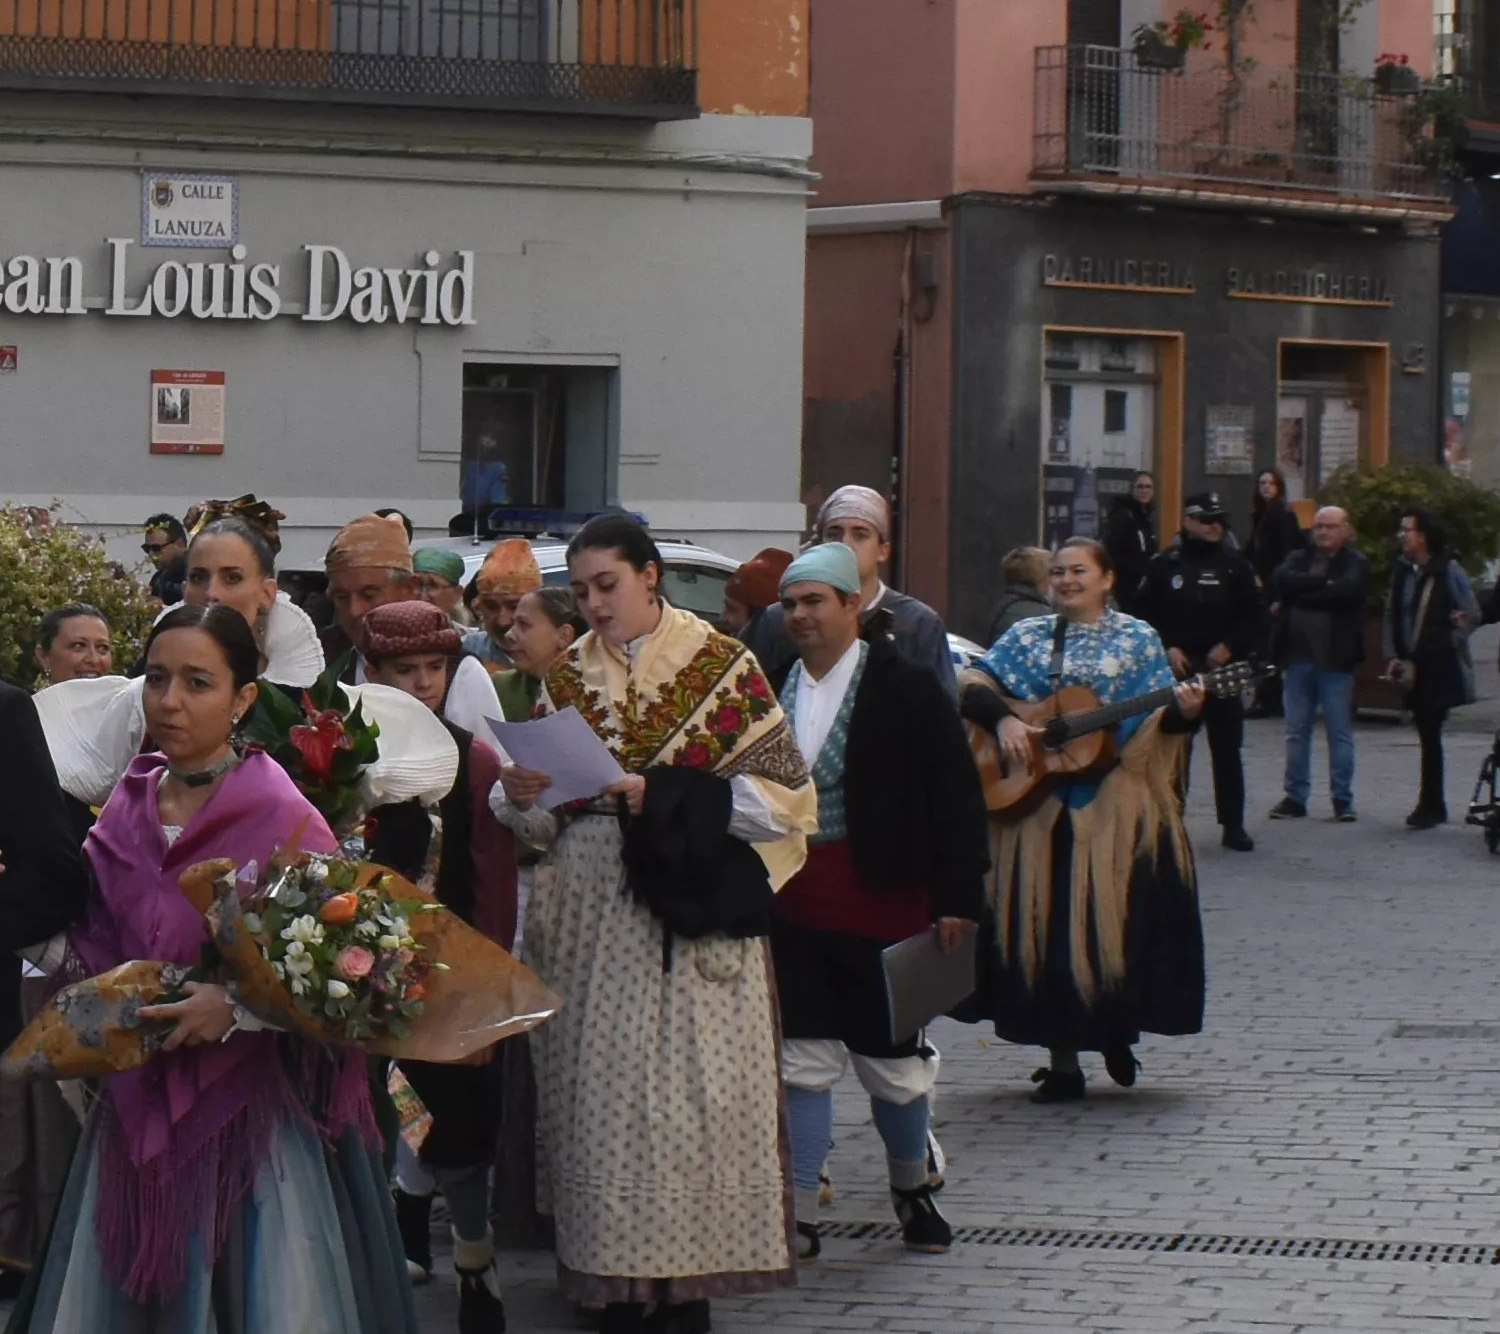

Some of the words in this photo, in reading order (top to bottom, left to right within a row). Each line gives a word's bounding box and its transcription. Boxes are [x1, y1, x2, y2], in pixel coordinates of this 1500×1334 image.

[182, 184, 225, 201] CALLE
[154, 218, 226, 238] LANUZA
[104, 238, 281, 321] Louis
[302, 244, 478, 326] David
